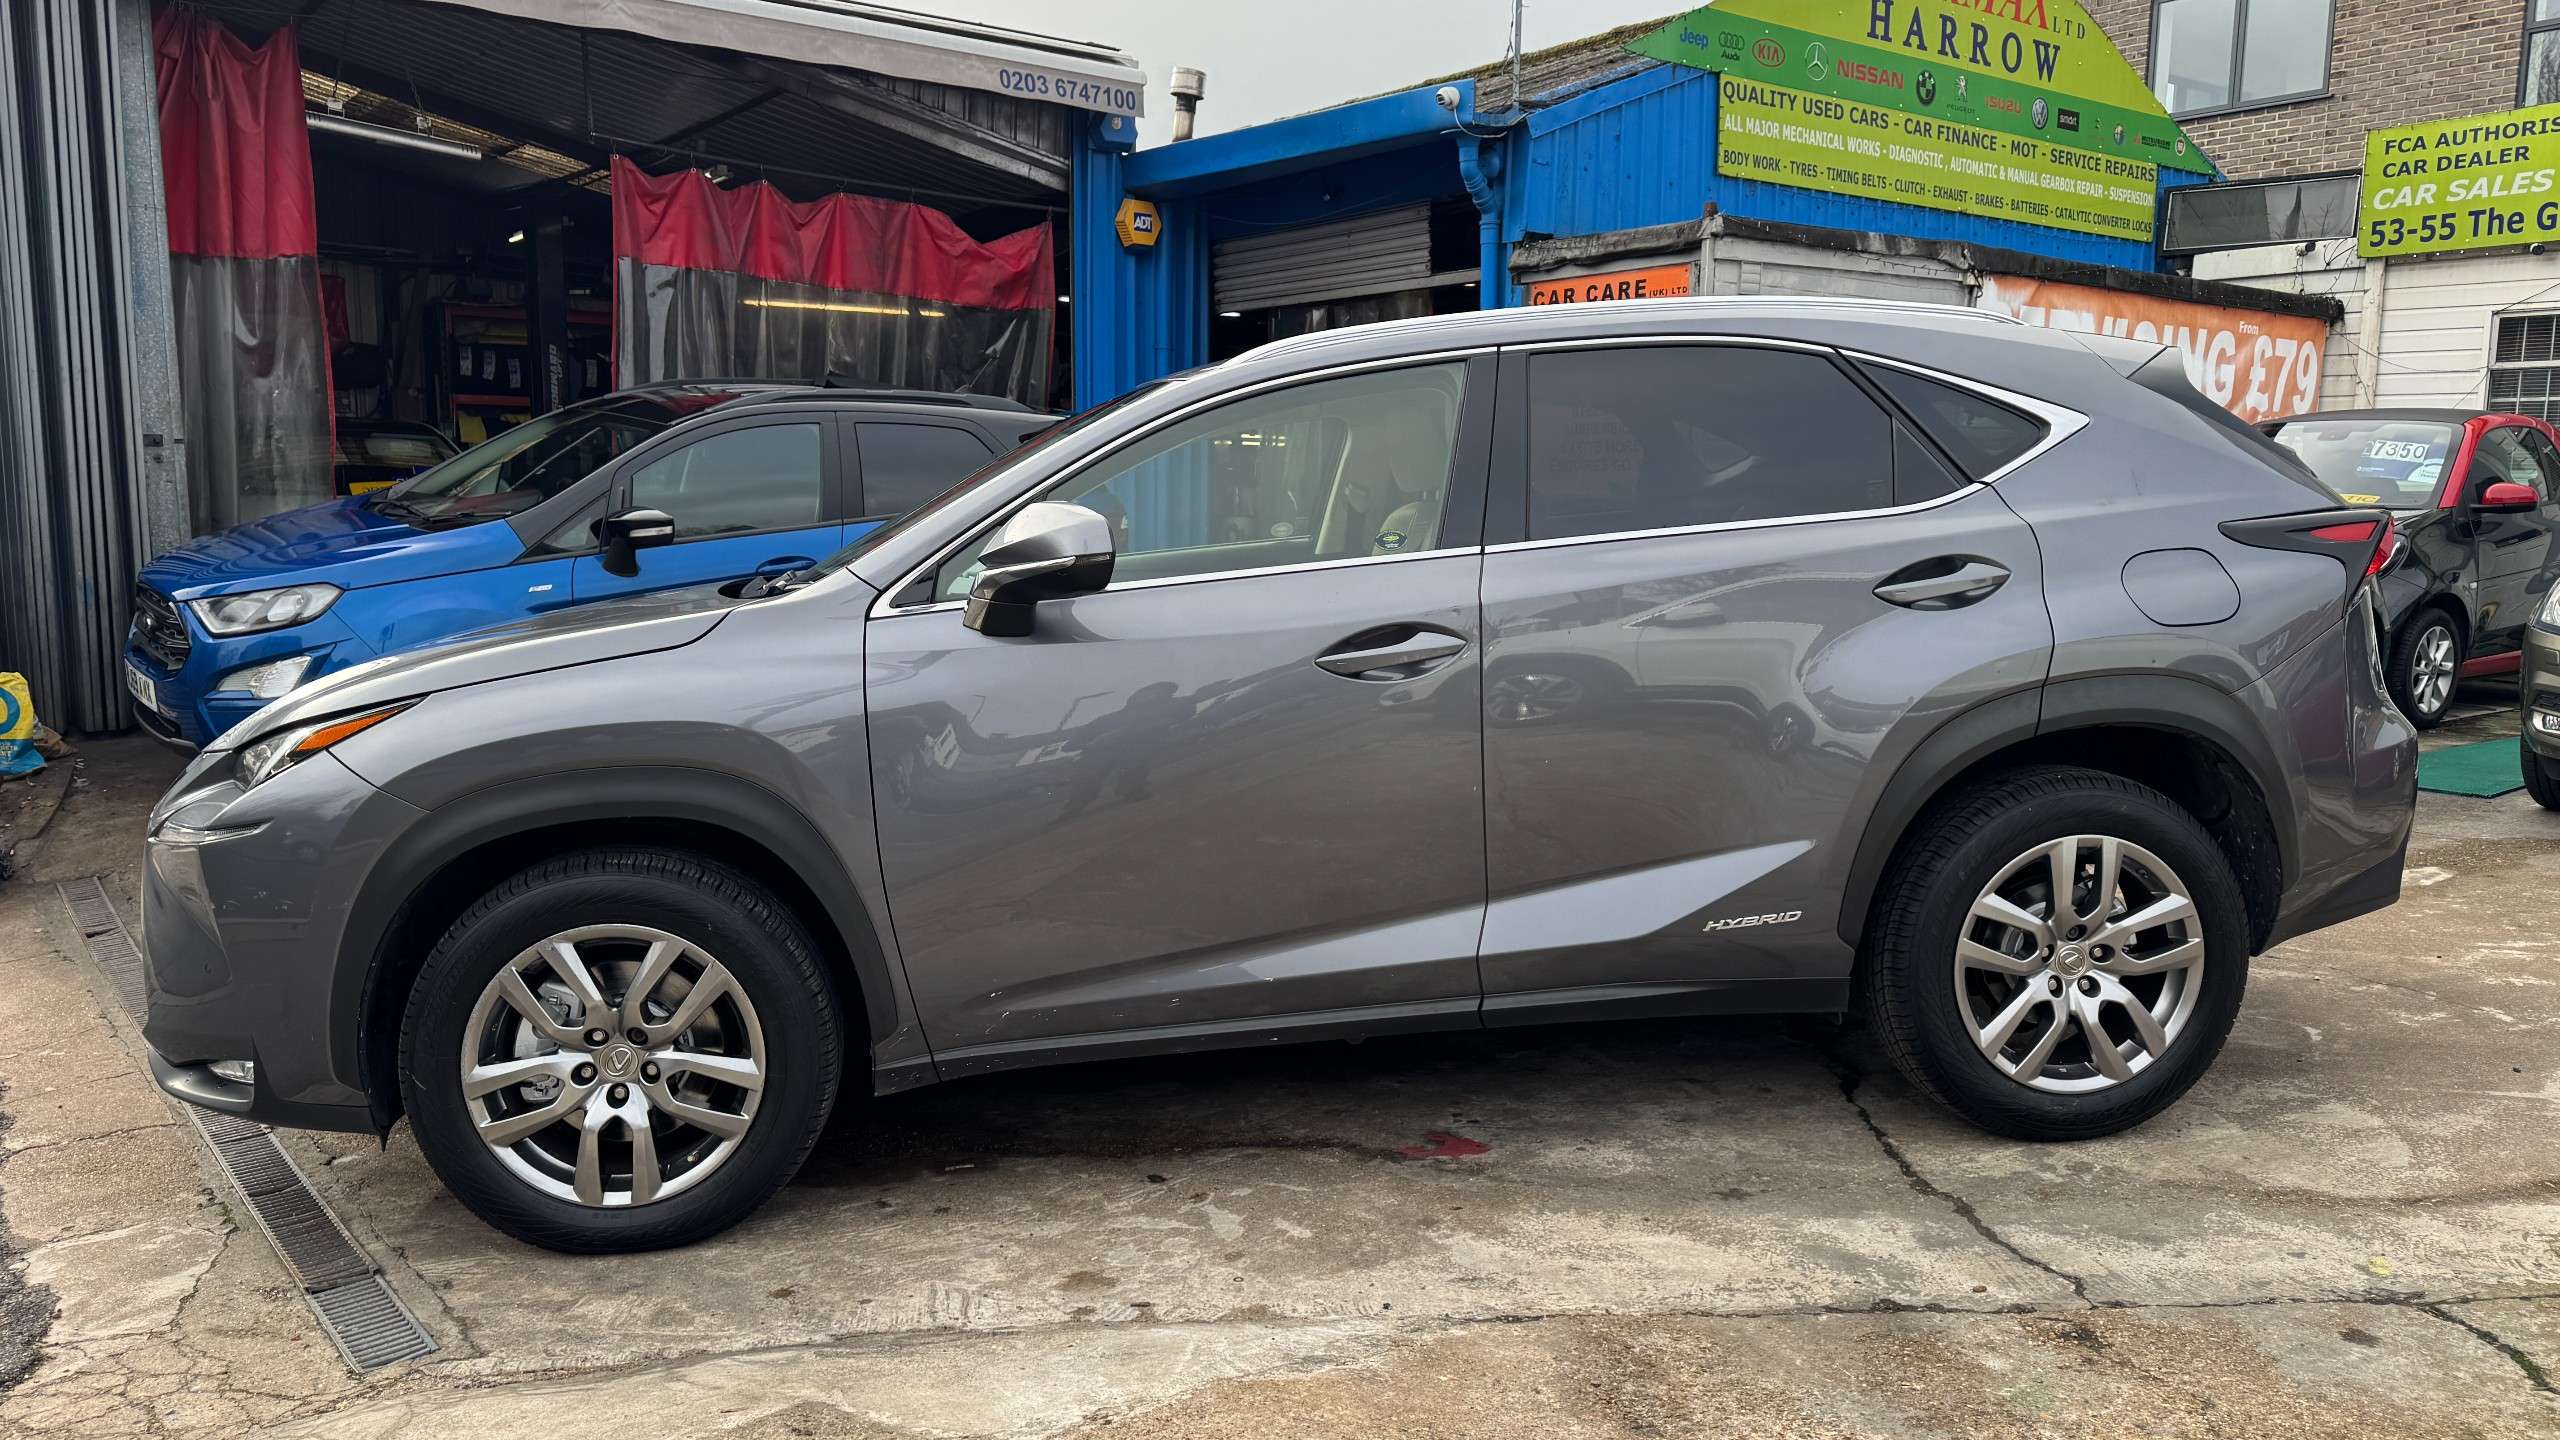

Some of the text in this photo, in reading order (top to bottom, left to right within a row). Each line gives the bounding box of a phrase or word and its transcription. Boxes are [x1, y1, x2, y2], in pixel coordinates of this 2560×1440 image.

[1680, 27, 1709, 49] Jeep
[1867, 0, 2061, 83] HARROW
[2053, 16, 2086, 40] LTD
[1721, 50, 1741, 62] Audi
[1757, 49, 1780, 63] KIA
[999, 69, 1136, 110] 0203 6747100
[1836, 59, 1904, 90] NISSAN
[1723, 80, 1797, 111] QUALITY
[1803, 97, 1844, 120] USED
[1850, 106, 1889, 129] CARS
[1904, 118, 1933, 138] CAR
[1937, 124, 1998, 151] FINANCE
[2010, 140, 2039, 158] MOT
[2049, 148, 2102, 172] SERVICE
[2105, 160, 2155, 182] REPAIRS
[2384, 136, 2427, 155] FCA
[1724, 114, 1744, 132] ALL
[1745, 118, 1780, 139] MAJOR
[1782, 125, 1845, 151] MECHANICAL
[1847, 136, 1881, 157] WORKS
[1889, 143, 1944, 168] DIAGNOSTIC
[1950, 156, 1998, 179] AUTOMATIC
[1999, 168, 2006, 180] &
[2007, 167, 2039, 186] MANUAL
[2040, 173, 2075, 194] GEARBOX
[2076, 180, 2104, 198] REPAIR
[2109, 186, 2154, 207] SUSPENSION
[2382, 145, 2530, 178] CAR DEALER
[1723, 149, 1750, 167] BODY
[1752, 154, 1781, 172] WORK
[1789, 160, 1818, 178] TYRES
[1826, 167, 1859, 185] TIMING
[1861, 173, 1887, 190] BELTS
[1894, 178, 1926, 196] CLUTCH
[1933, 185, 1968, 203] EXHAUST
[1975, 192, 2004, 209] BRAKES
[2010, 198, 2049, 217] BATTERIES
[2055, 207, 2093, 225] CATALYTIC
[2093, 213, 2131, 231] CONVERTER
[2131, 219, 2153, 234] LOCKS
[2373, 168, 2555, 209] CAR SALES
[1133, 215, 1153, 231] ADT
[2369, 212, 2457, 248] 53-55
[2468, 206, 2525, 238] The
[1533, 279, 1688, 306] CAR CARE (UK) LTD
[2239, 320, 2260, 335] From
[2246, 335, 2318, 415] £79
[1703, 911, 1802, 932] HYBRID
